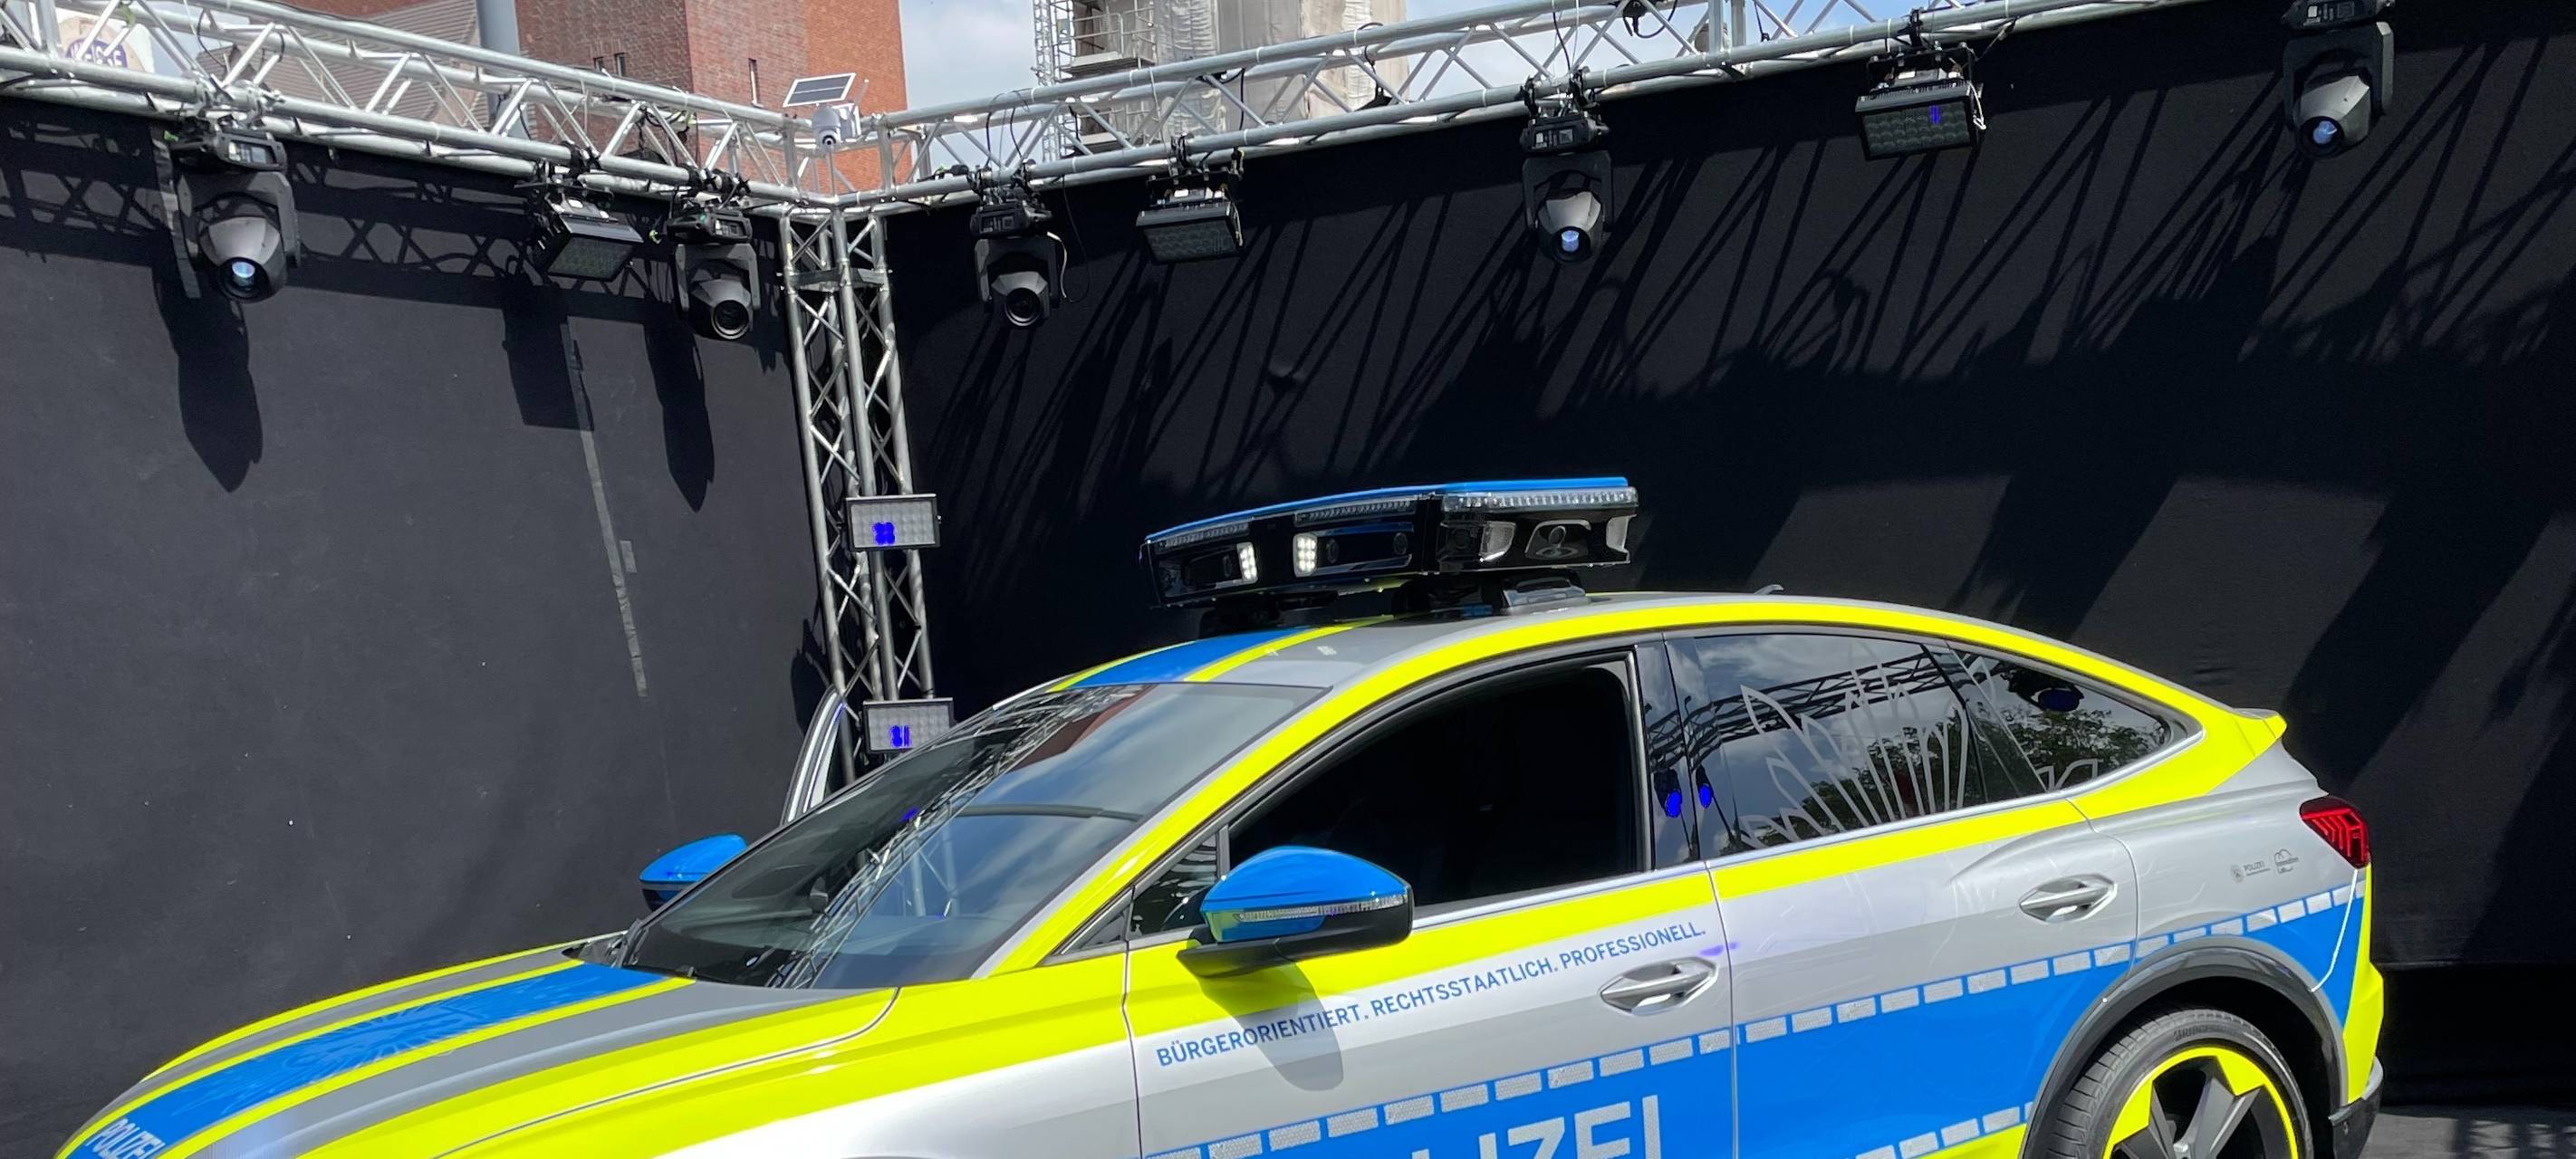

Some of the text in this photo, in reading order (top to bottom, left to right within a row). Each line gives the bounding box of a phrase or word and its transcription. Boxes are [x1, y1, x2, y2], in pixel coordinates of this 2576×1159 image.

[1156, 922, 1706, 1067] BÜRGERORIENTIERT. RECHTSSTAATLICH. PROFESSIONELL.
